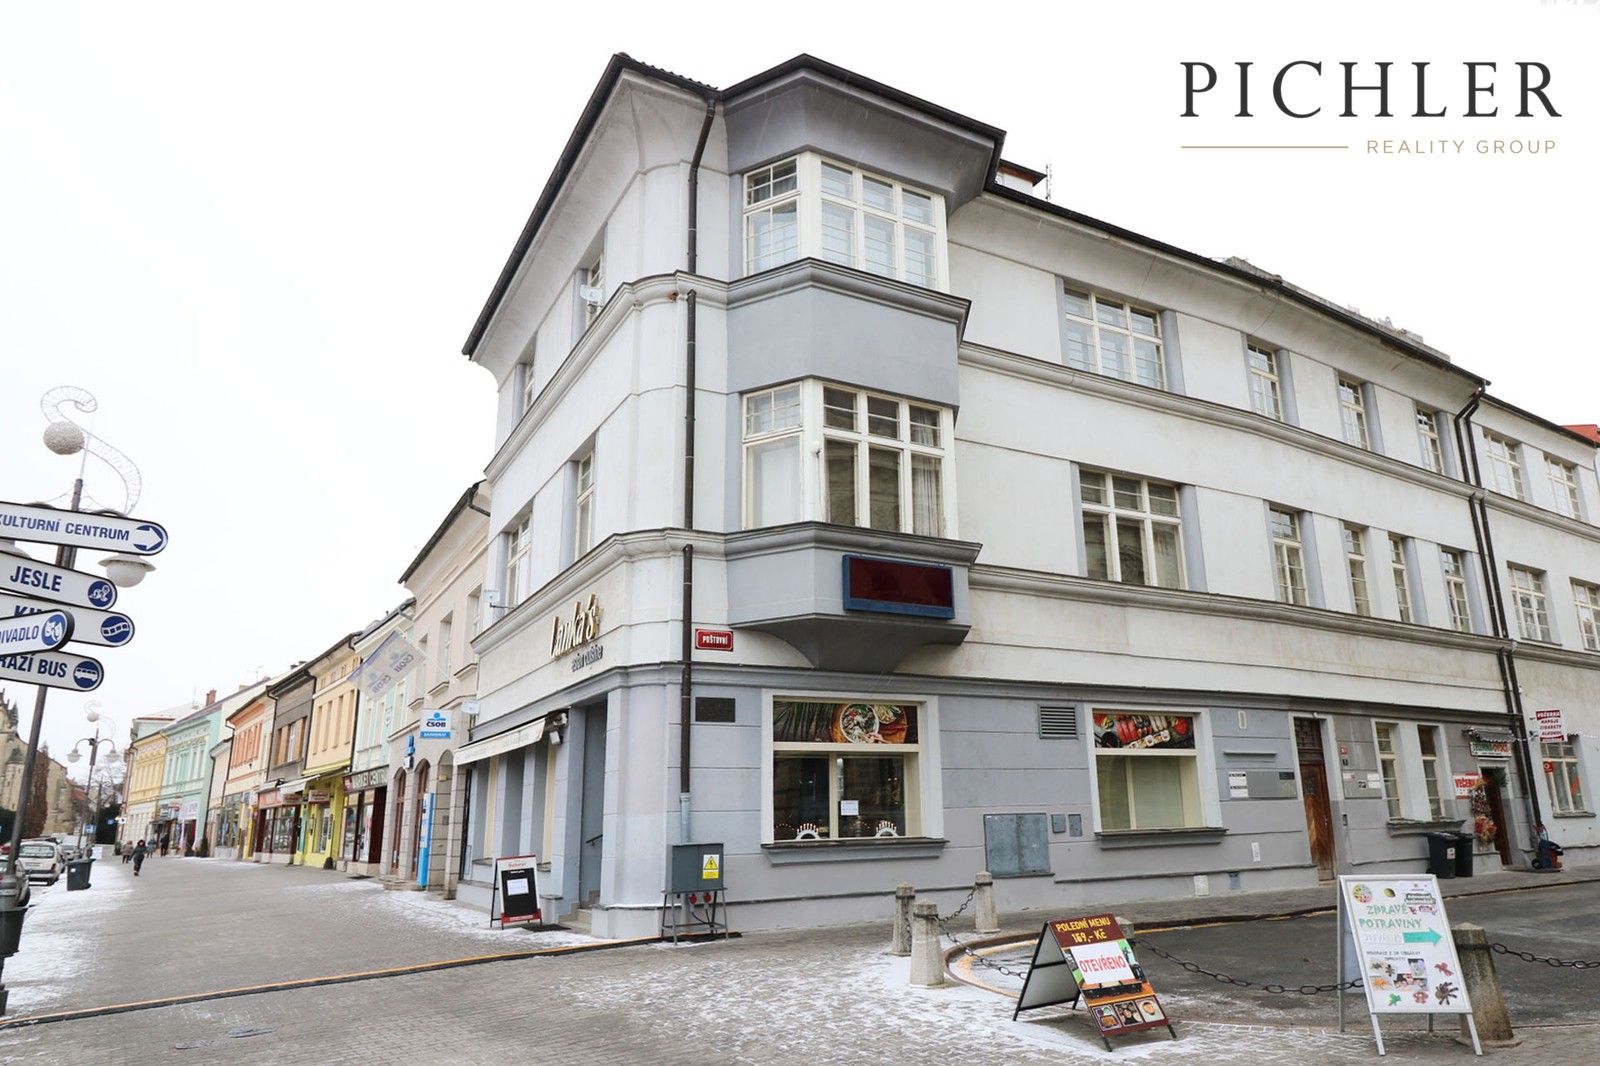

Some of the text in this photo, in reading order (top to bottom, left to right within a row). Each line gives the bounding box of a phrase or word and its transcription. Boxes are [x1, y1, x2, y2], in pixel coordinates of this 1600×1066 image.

[65, 522, 130, 541] CENTRUM
[10, 565, 62, 592] JESLE
[0, 625, 39, 644] IVADLO
[702, 634, 728, 645] POŠTOVNÍ
[37, 658, 67, 678] BUS
[426, 720, 446, 728] ČSOB
[1366, 902, 1408, 915] ZDRAVÉ
[1055, 917, 1111, 932] POLEDNÍ MENU
[1358, 917, 1421, 929] POTRAVINY
[1095, 929, 1108, 941] Kč
[1079, 955, 1127, 973] OTEVŘENO
